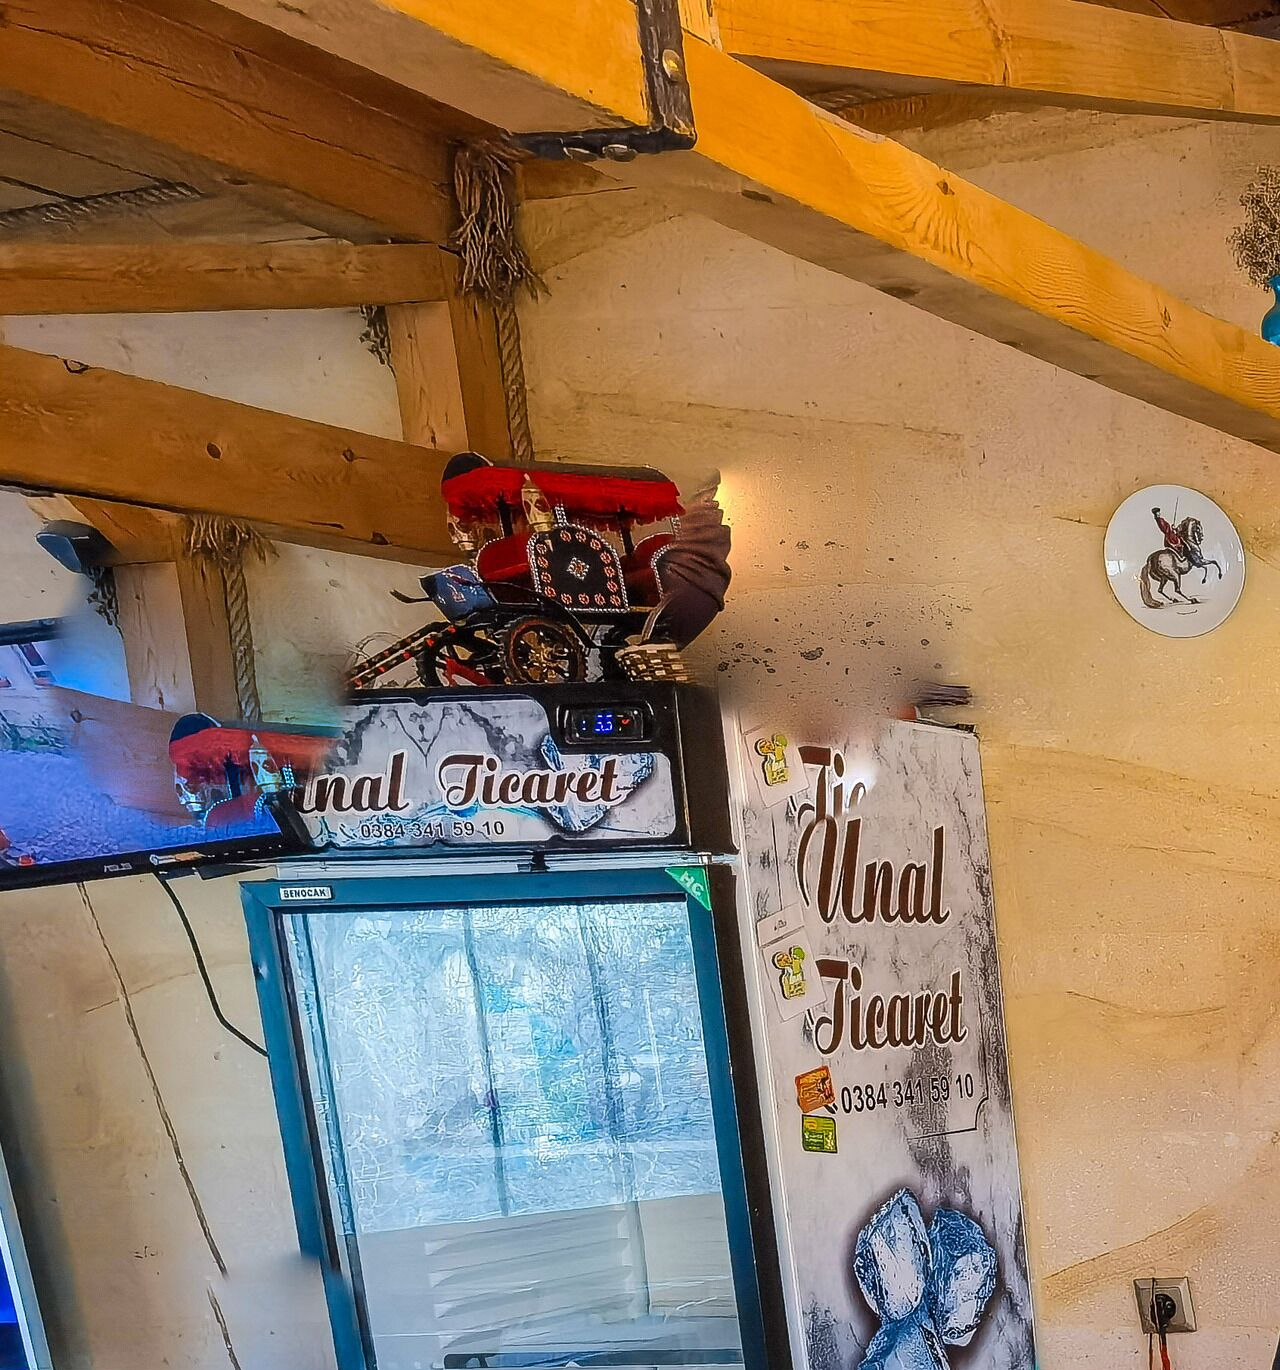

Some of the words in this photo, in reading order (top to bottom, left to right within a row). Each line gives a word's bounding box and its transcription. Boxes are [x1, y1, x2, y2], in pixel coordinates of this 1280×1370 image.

[439, 754, 623, 806] Ticaret
[361, 821, 405, 838] 0384
[413, 820, 444, 838] 341
[453, 820, 475, 837] 59
[482, 820, 505, 836] 10
[815, 959, 967, 1054] Ticaret
[841, 1083, 888, 1114] 0384
[893, 1079, 924, 1107] 341
[931, 1076, 950, 1102] 59
[956, 1073, 974, 1098] 10
